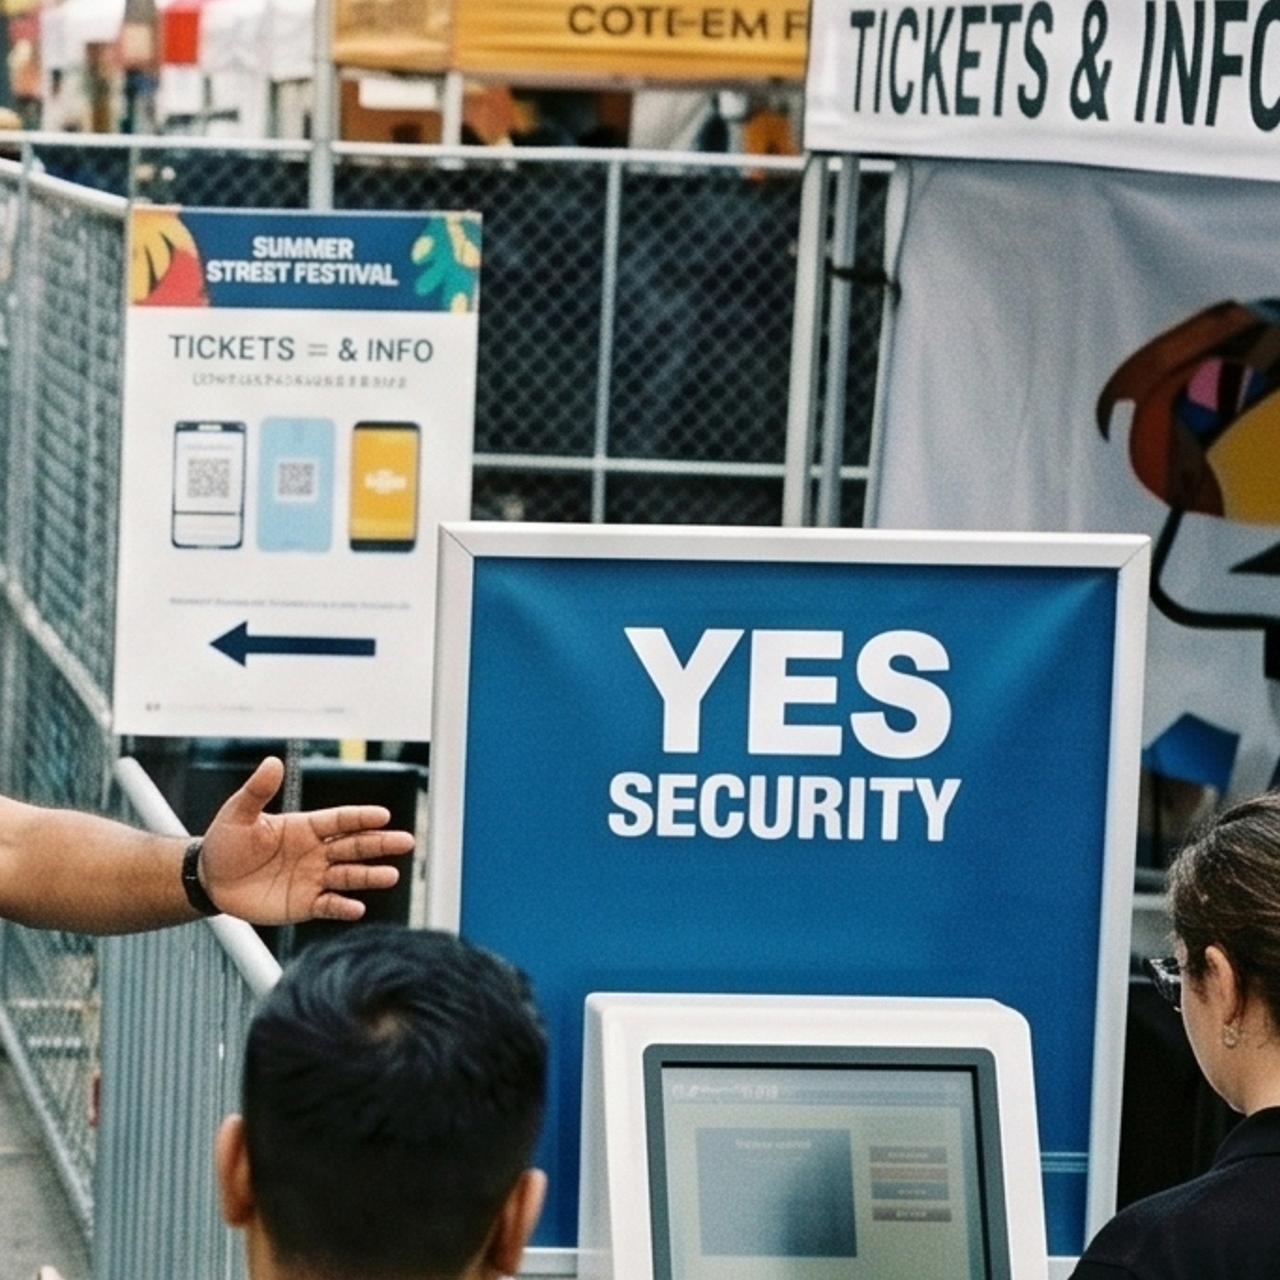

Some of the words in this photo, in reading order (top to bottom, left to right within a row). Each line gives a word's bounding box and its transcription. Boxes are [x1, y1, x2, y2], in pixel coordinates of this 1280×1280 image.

[850, 0, 1054, 120] TICKETS
[252, 235, 355, 260] SUMMER
[293, 261, 400, 287] FESTIVAL
[169, 334, 295, 362] TICKETS
[338, 337, 357, 361] &
[367, 338, 434, 363] INFO
[623, 626, 952, 759] YES
[608, 771, 962, 842] SECURITY
